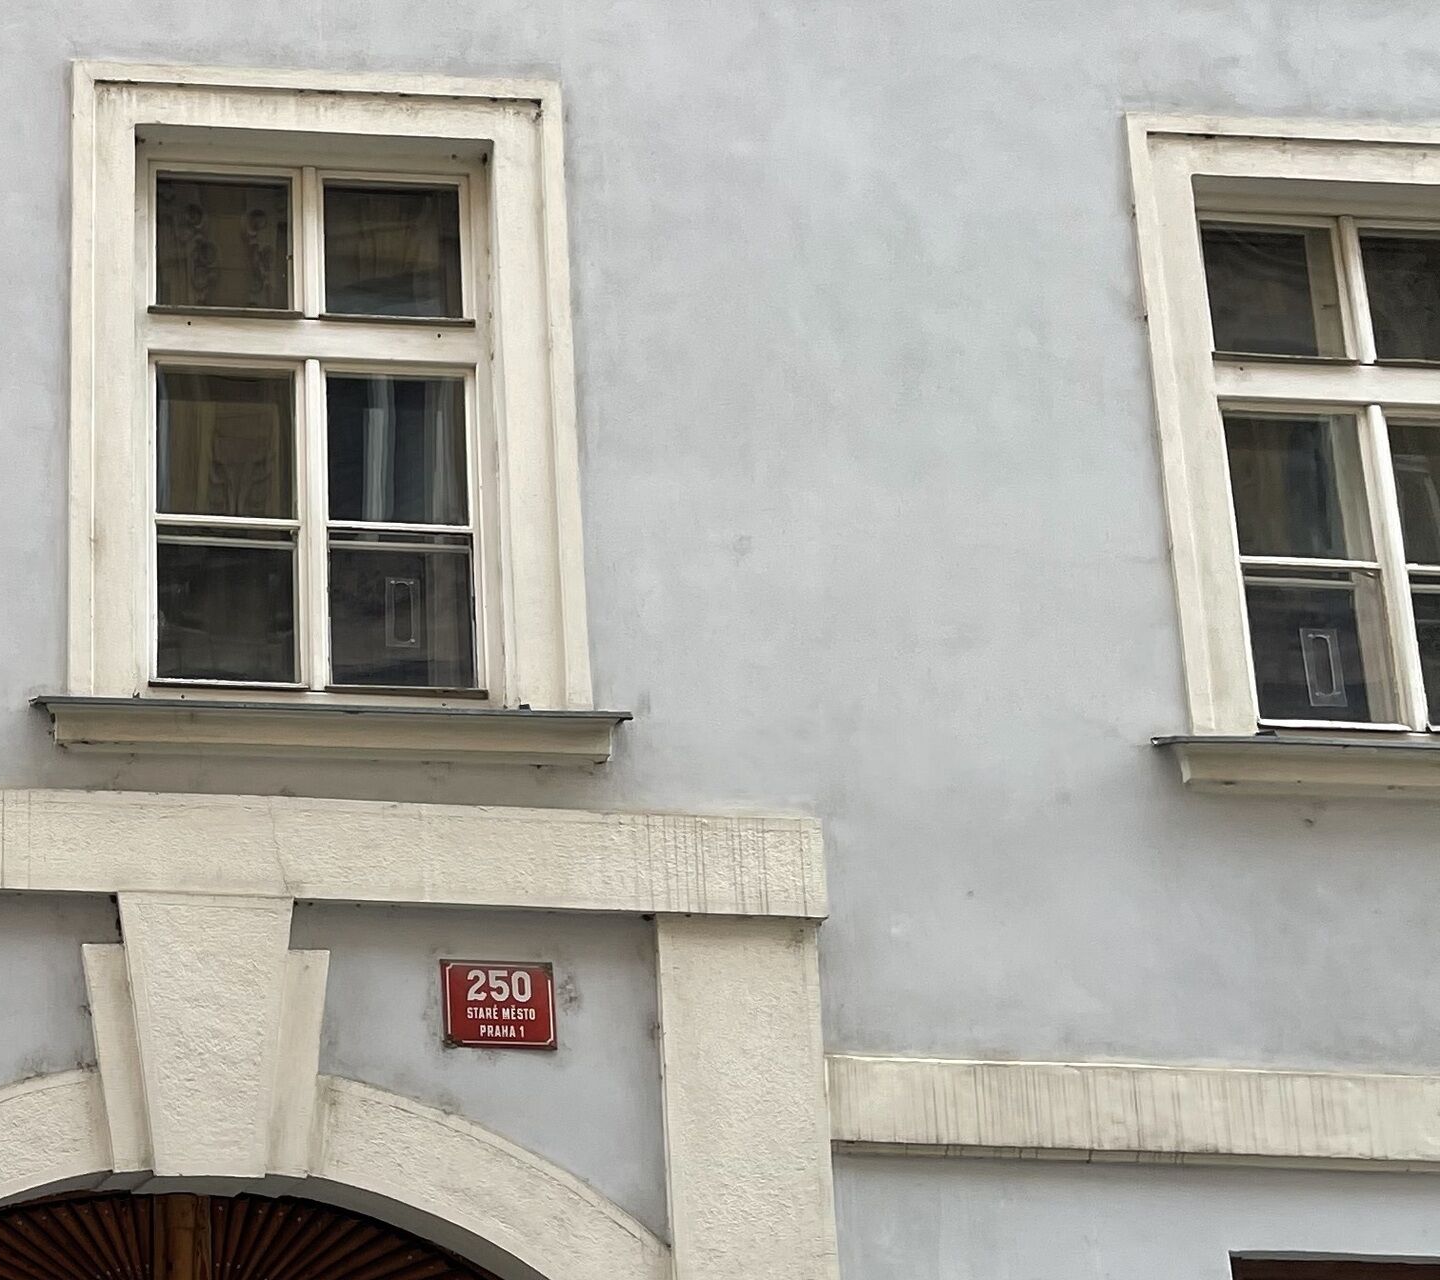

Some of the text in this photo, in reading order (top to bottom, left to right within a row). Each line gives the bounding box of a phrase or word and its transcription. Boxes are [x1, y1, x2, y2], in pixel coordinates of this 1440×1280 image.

[467, 970, 532, 1002] 250
[467, 1005, 536, 1020] STARÉ MĚSTO
[479, 1024, 525, 1038] PRAHA 1
